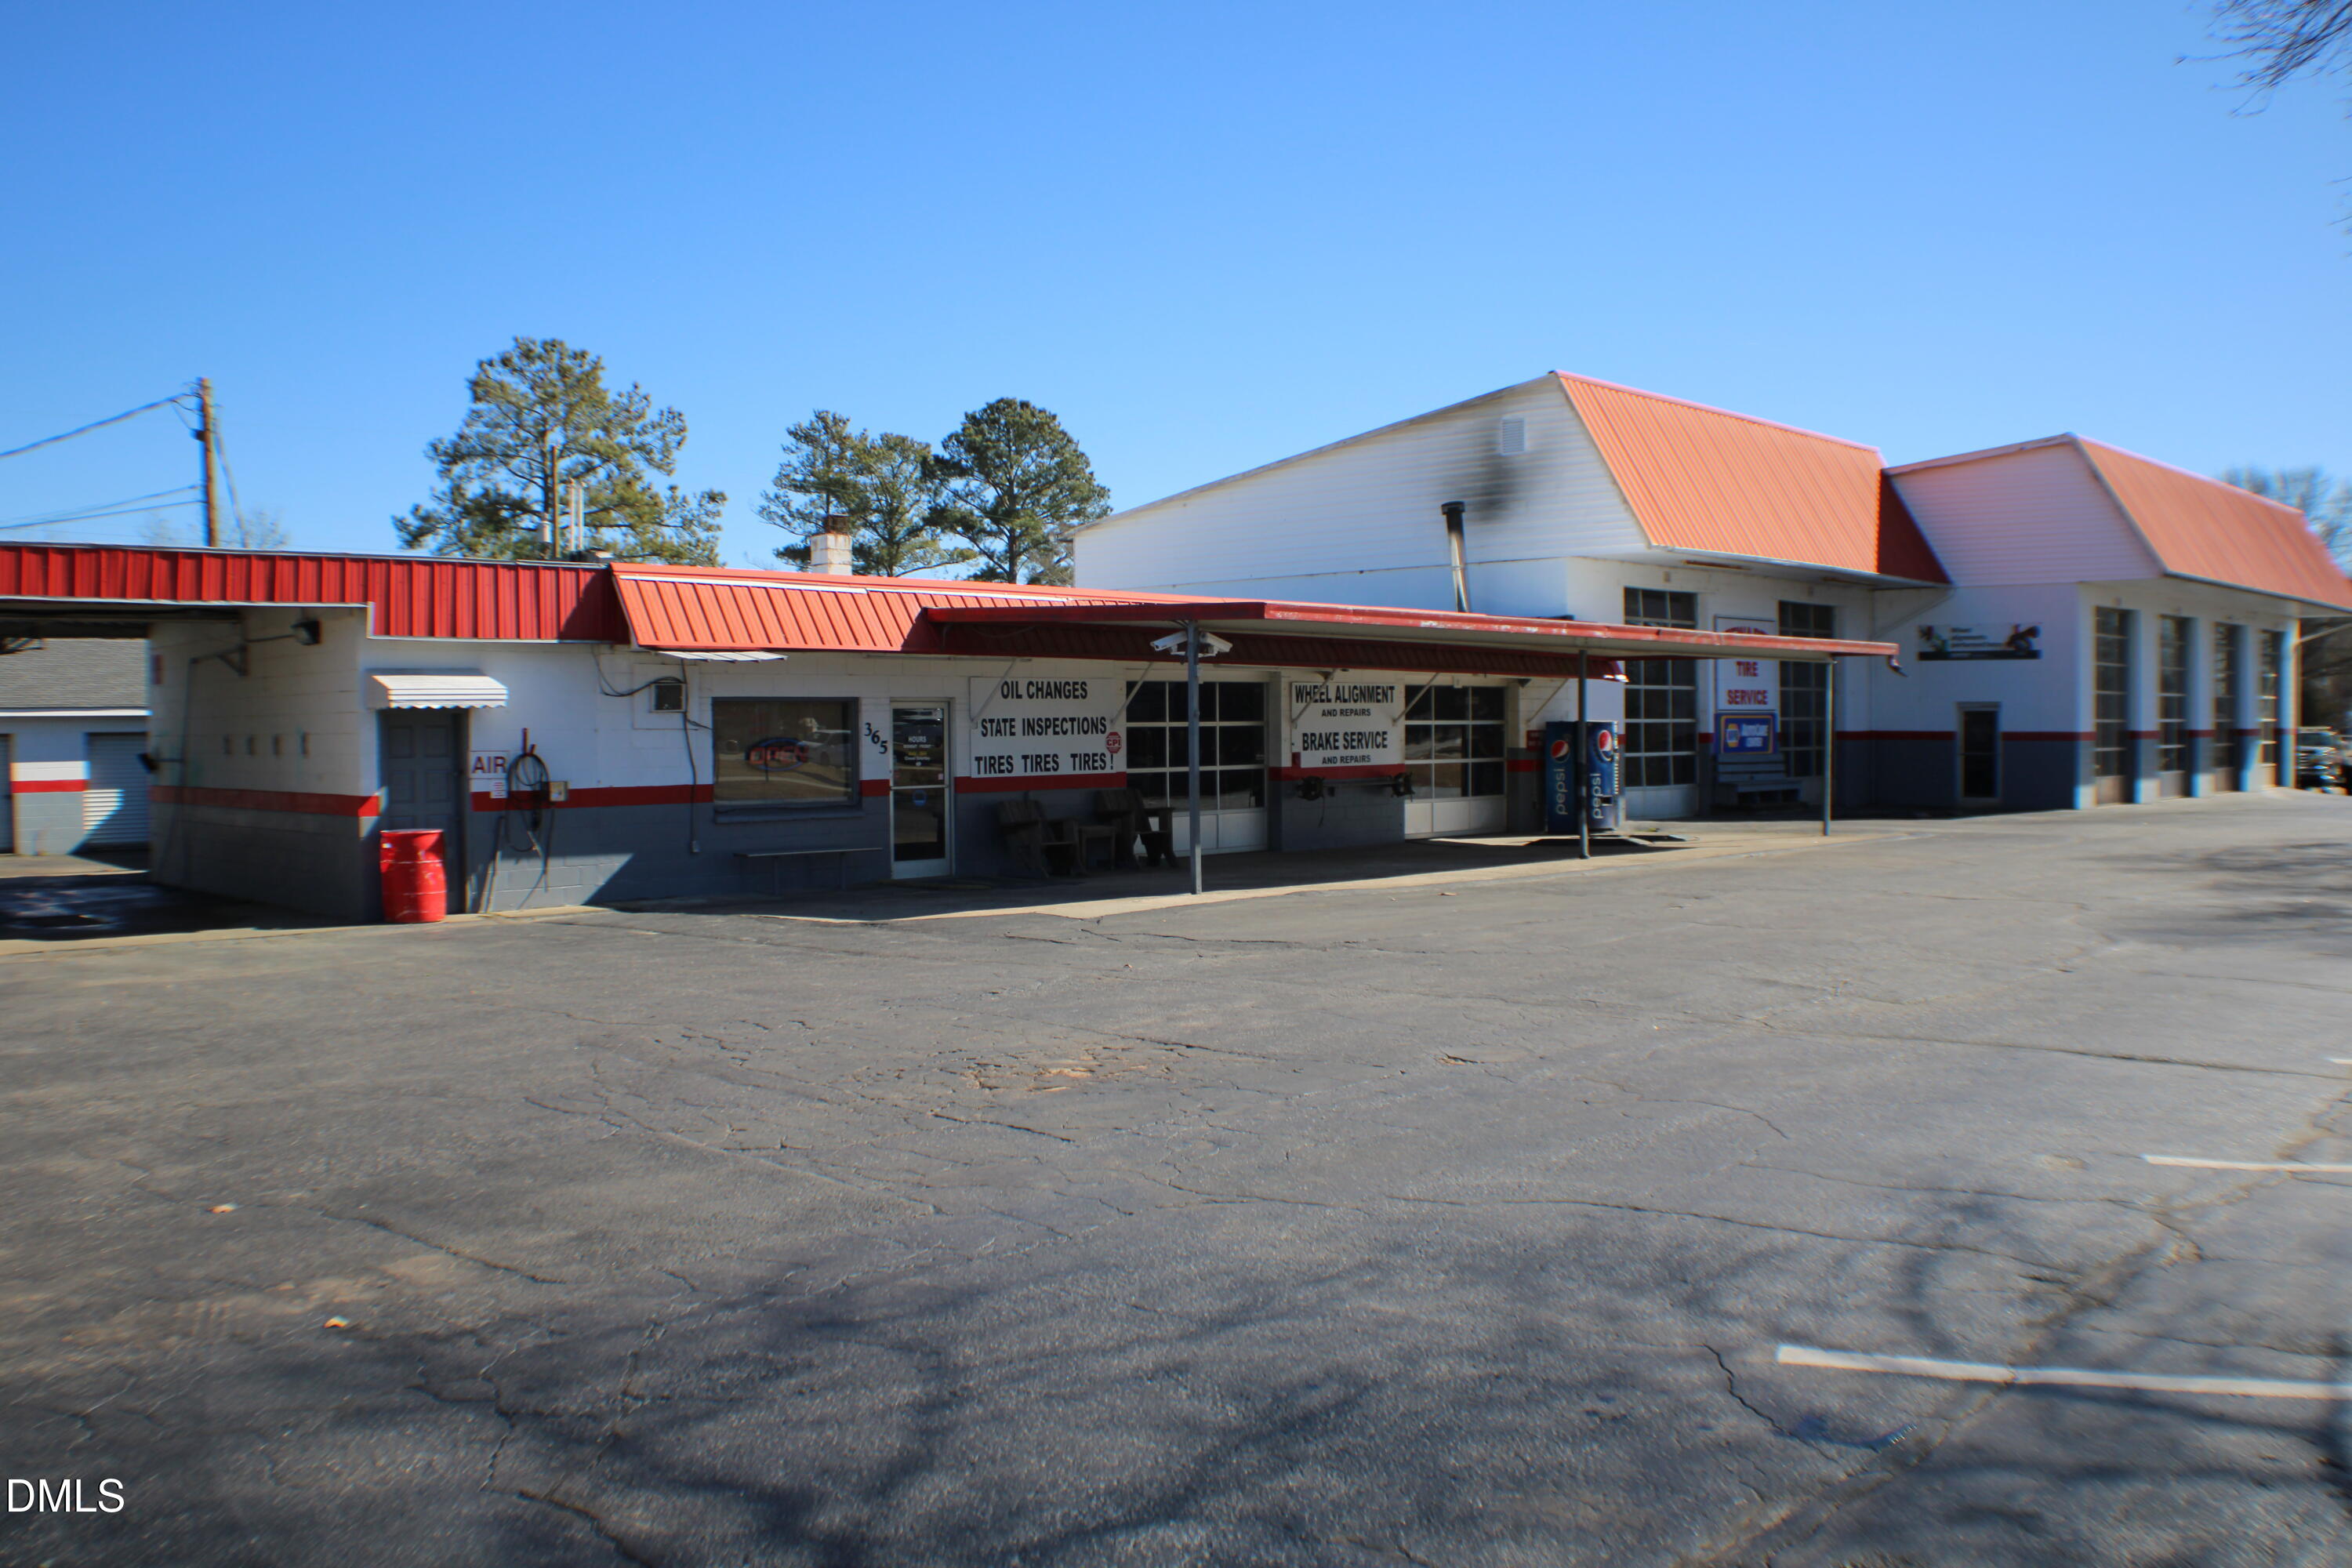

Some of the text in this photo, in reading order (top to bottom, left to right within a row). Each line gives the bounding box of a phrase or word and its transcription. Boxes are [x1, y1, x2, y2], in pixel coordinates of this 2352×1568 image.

[1735, 661, 1759, 677] TIRE
[1000, 681, 1088, 699] OIL CHANGES
[1295, 684, 1396, 703] WHEEL ALIGNMENT
[1726, 689, 1769, 706] SERVICE
[1321, 708, 1371, 717] AND REPAIRS
[981, 716, 1107, 737] STATE INSPECTIONS
[864, 722, 887, 754] 365
[1302, 731, 1388, 751] BRAKE SERVICE
[472, 756, 507, 774] AIR
[975, 754, 1014, 775] TIRES
[1022, 753, 1059, 773] TIRES
[1322, 755, 1371, 764] AND REPAIRS
[1554, 768, 1569, 815] pepsi
[1590, 773, 1604, 819] pepsi
